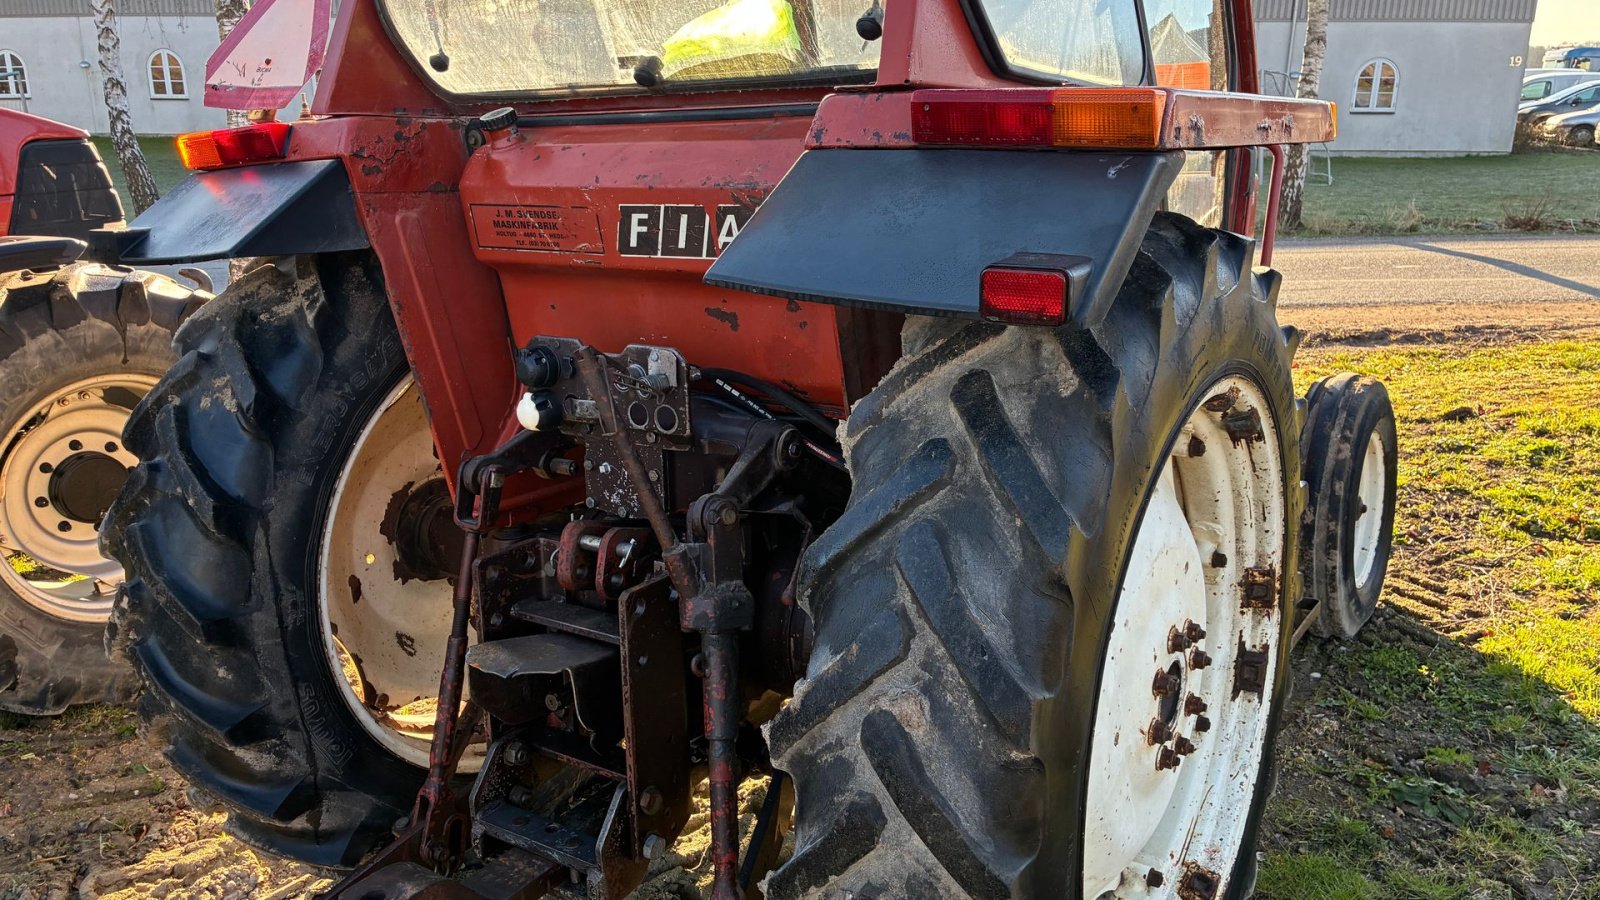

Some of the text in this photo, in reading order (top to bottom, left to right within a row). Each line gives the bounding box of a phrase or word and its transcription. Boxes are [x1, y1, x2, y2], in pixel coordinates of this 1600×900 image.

[1509, 55, 1522, 67] 19
[495, 209, 561, 219] J. M. SVENDSE
[493, 219, 559, 230] MASKINFABRIK
[630, 213, 742, 249] FIA
